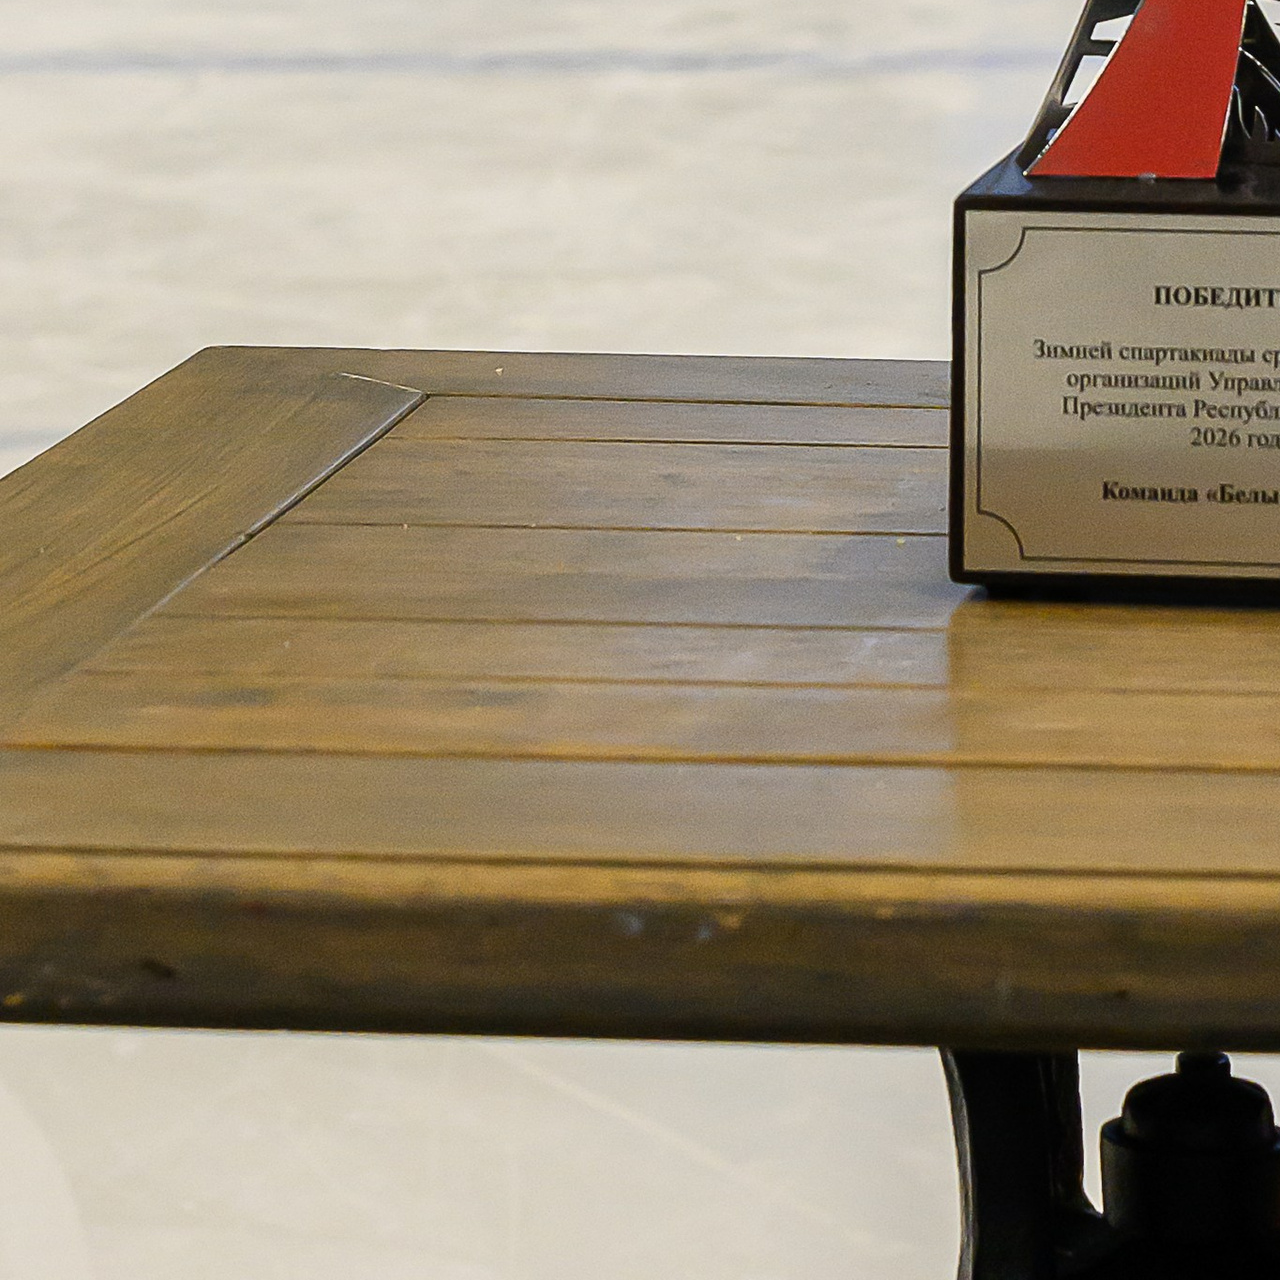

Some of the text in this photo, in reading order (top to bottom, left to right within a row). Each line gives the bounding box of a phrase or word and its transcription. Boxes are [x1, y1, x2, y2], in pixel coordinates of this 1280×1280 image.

[1033, 339, 1113, 360] Зимней
[1118, 346, 1256, 367] спартакиады
[1066, 371, 1201, 393] организаций
[1062, 395, 1187, 422] Президента
[1190, 426, 1241, 448] 2026
[1102, 481, 1199, 504] Команда
